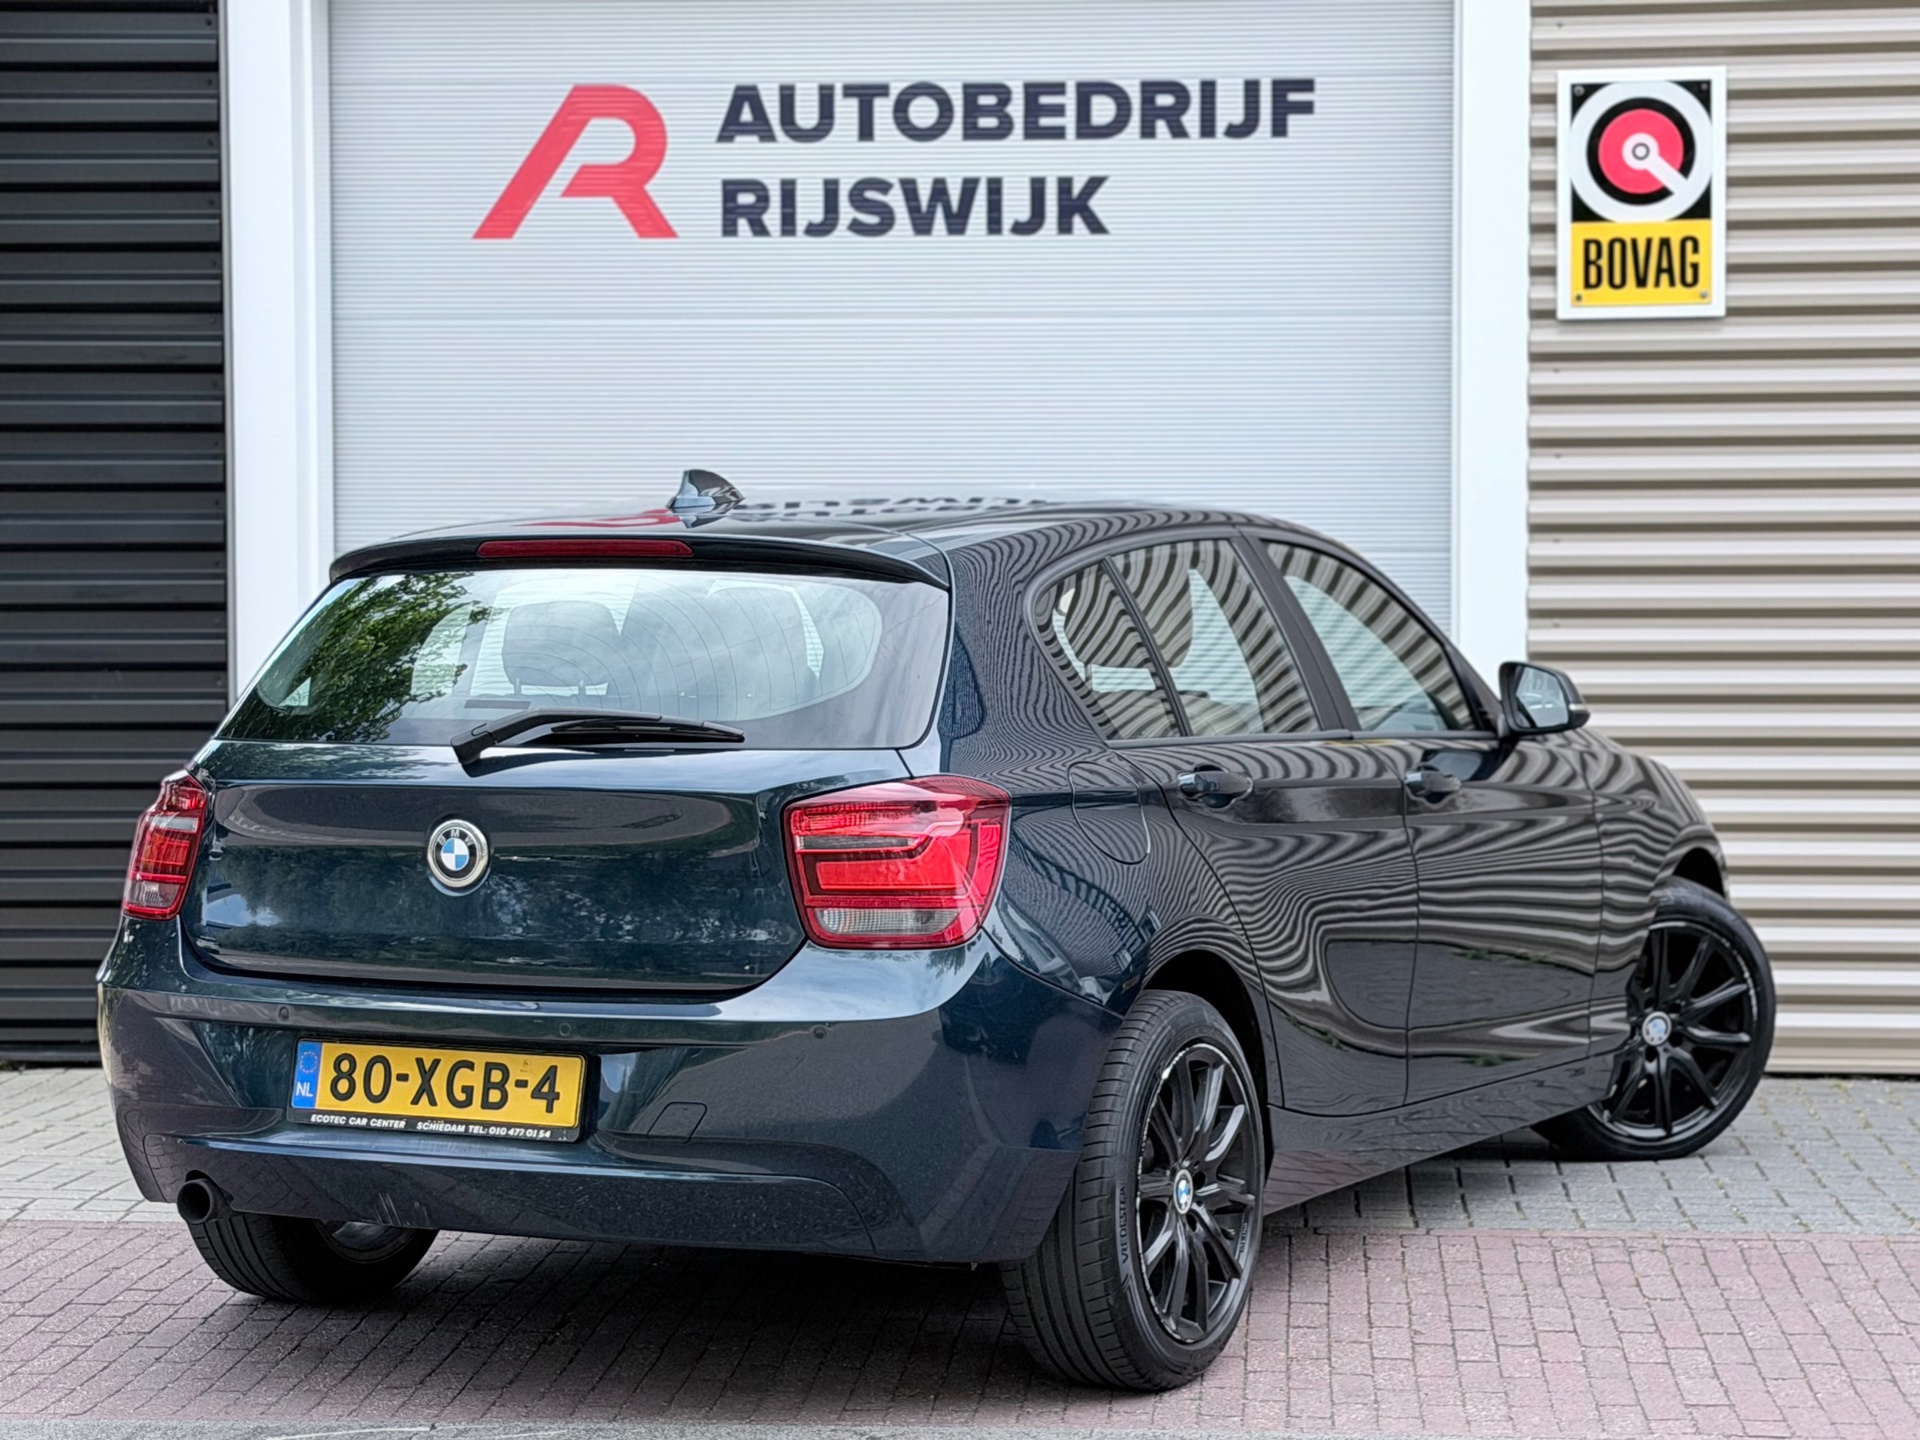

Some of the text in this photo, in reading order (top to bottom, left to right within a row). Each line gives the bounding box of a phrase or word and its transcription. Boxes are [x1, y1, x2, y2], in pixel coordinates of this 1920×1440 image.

[715, 78, 1316, 144] AUTOBEDRIJF
[720, 175, 1110, 238] RIJSWIJK
[1583, 235, 1700, 290] BOVAG
[437, 829, 475, 846] BMW
[295, 1081, 314, 1098] NL
[329, 1052, 561, 1114] 80-XGB-4
[310, 1114, 347, 1125] ECOTEC
[348, 1117, 368, 1126] CAR
[369, 1118, 407, 1129] CENTER
[416, 1121, 465, 1133] SCHIEDAM
[488, 1126, 507, 1136] 010
[508, 1128, 525, 1137] 477
[538, 1130, 552, 1139] 54
